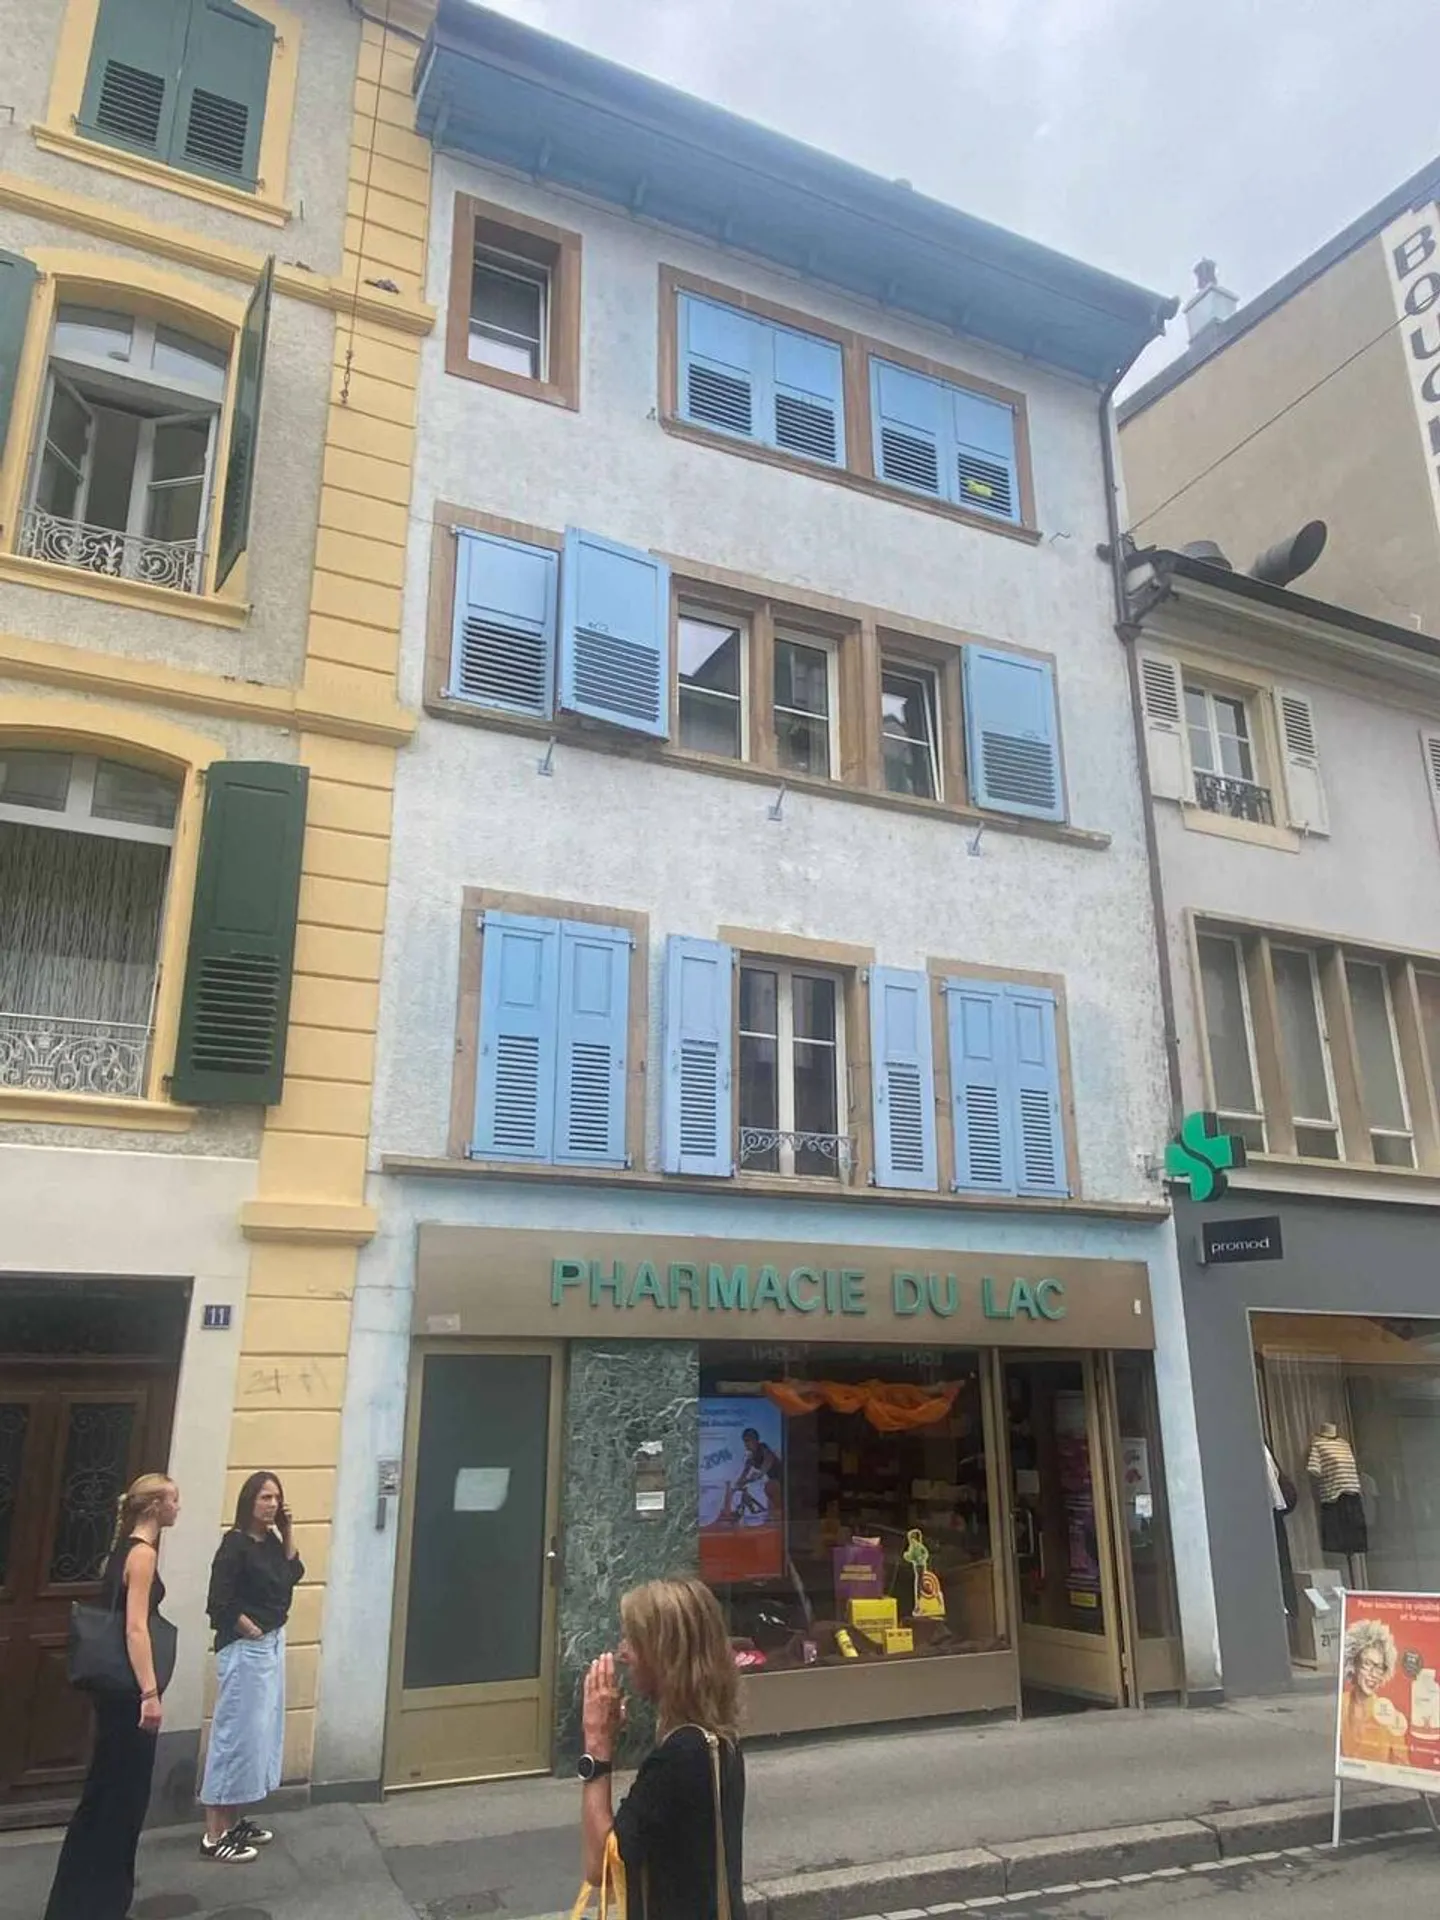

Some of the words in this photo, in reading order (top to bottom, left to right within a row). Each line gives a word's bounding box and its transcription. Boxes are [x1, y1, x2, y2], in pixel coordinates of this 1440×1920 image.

[1211, 1237, 1270, 1254] promod
[550, 1257, 867, 1316] PHARMACIE
[893, 1270, 958, 1317] DU
[983, 1275, 1067, 1321] LAC
[210, 1307, 226, 1325] 11
